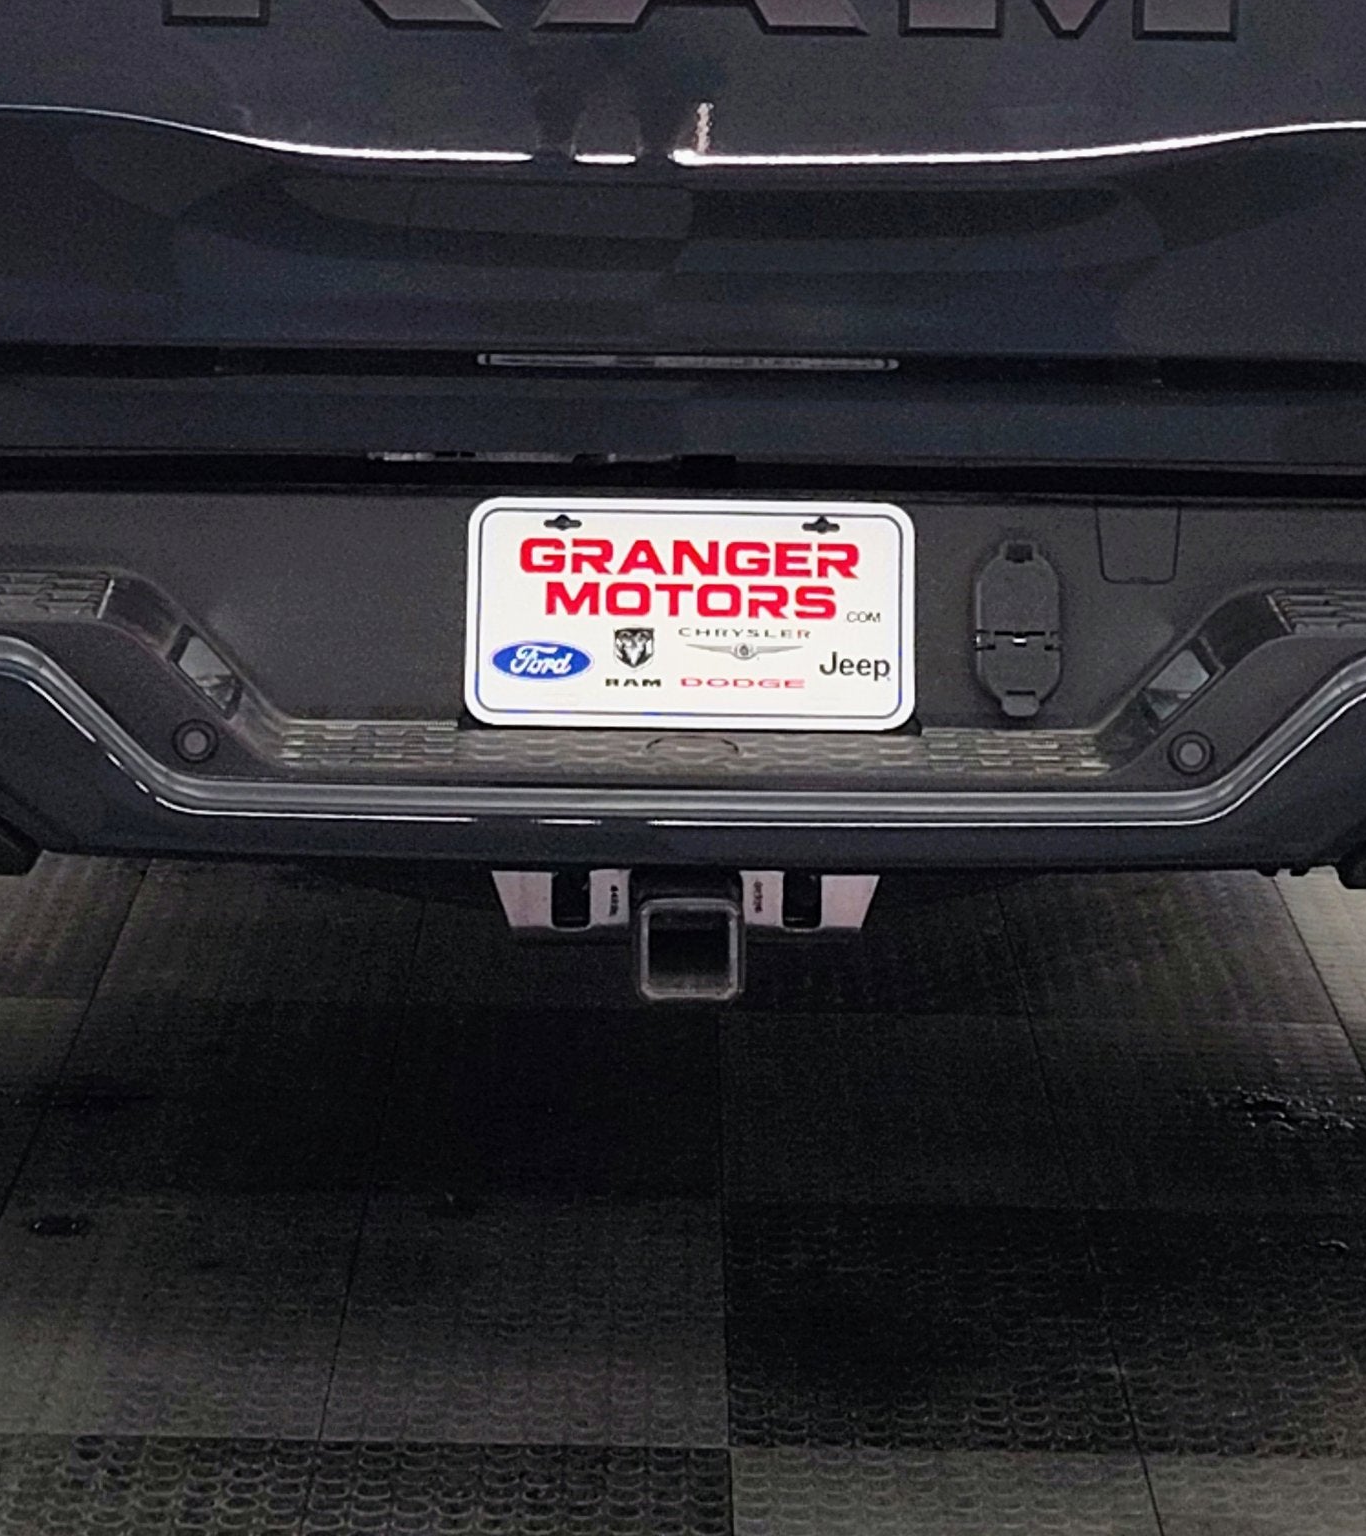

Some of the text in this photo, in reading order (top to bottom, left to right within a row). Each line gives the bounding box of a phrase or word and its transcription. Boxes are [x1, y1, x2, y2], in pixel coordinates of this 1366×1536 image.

[520, 537, 860, 579] GRANGER
[545, 581, 837, 620] MOTORS
[678, 627, 811, 639] CHRYSLER
[510, 645, 573, 675] Ford
[819, 651, 891, 681] Jeep
[605, 678, 662, 687] RAM
[680, 677, 805, 688] DODGE
